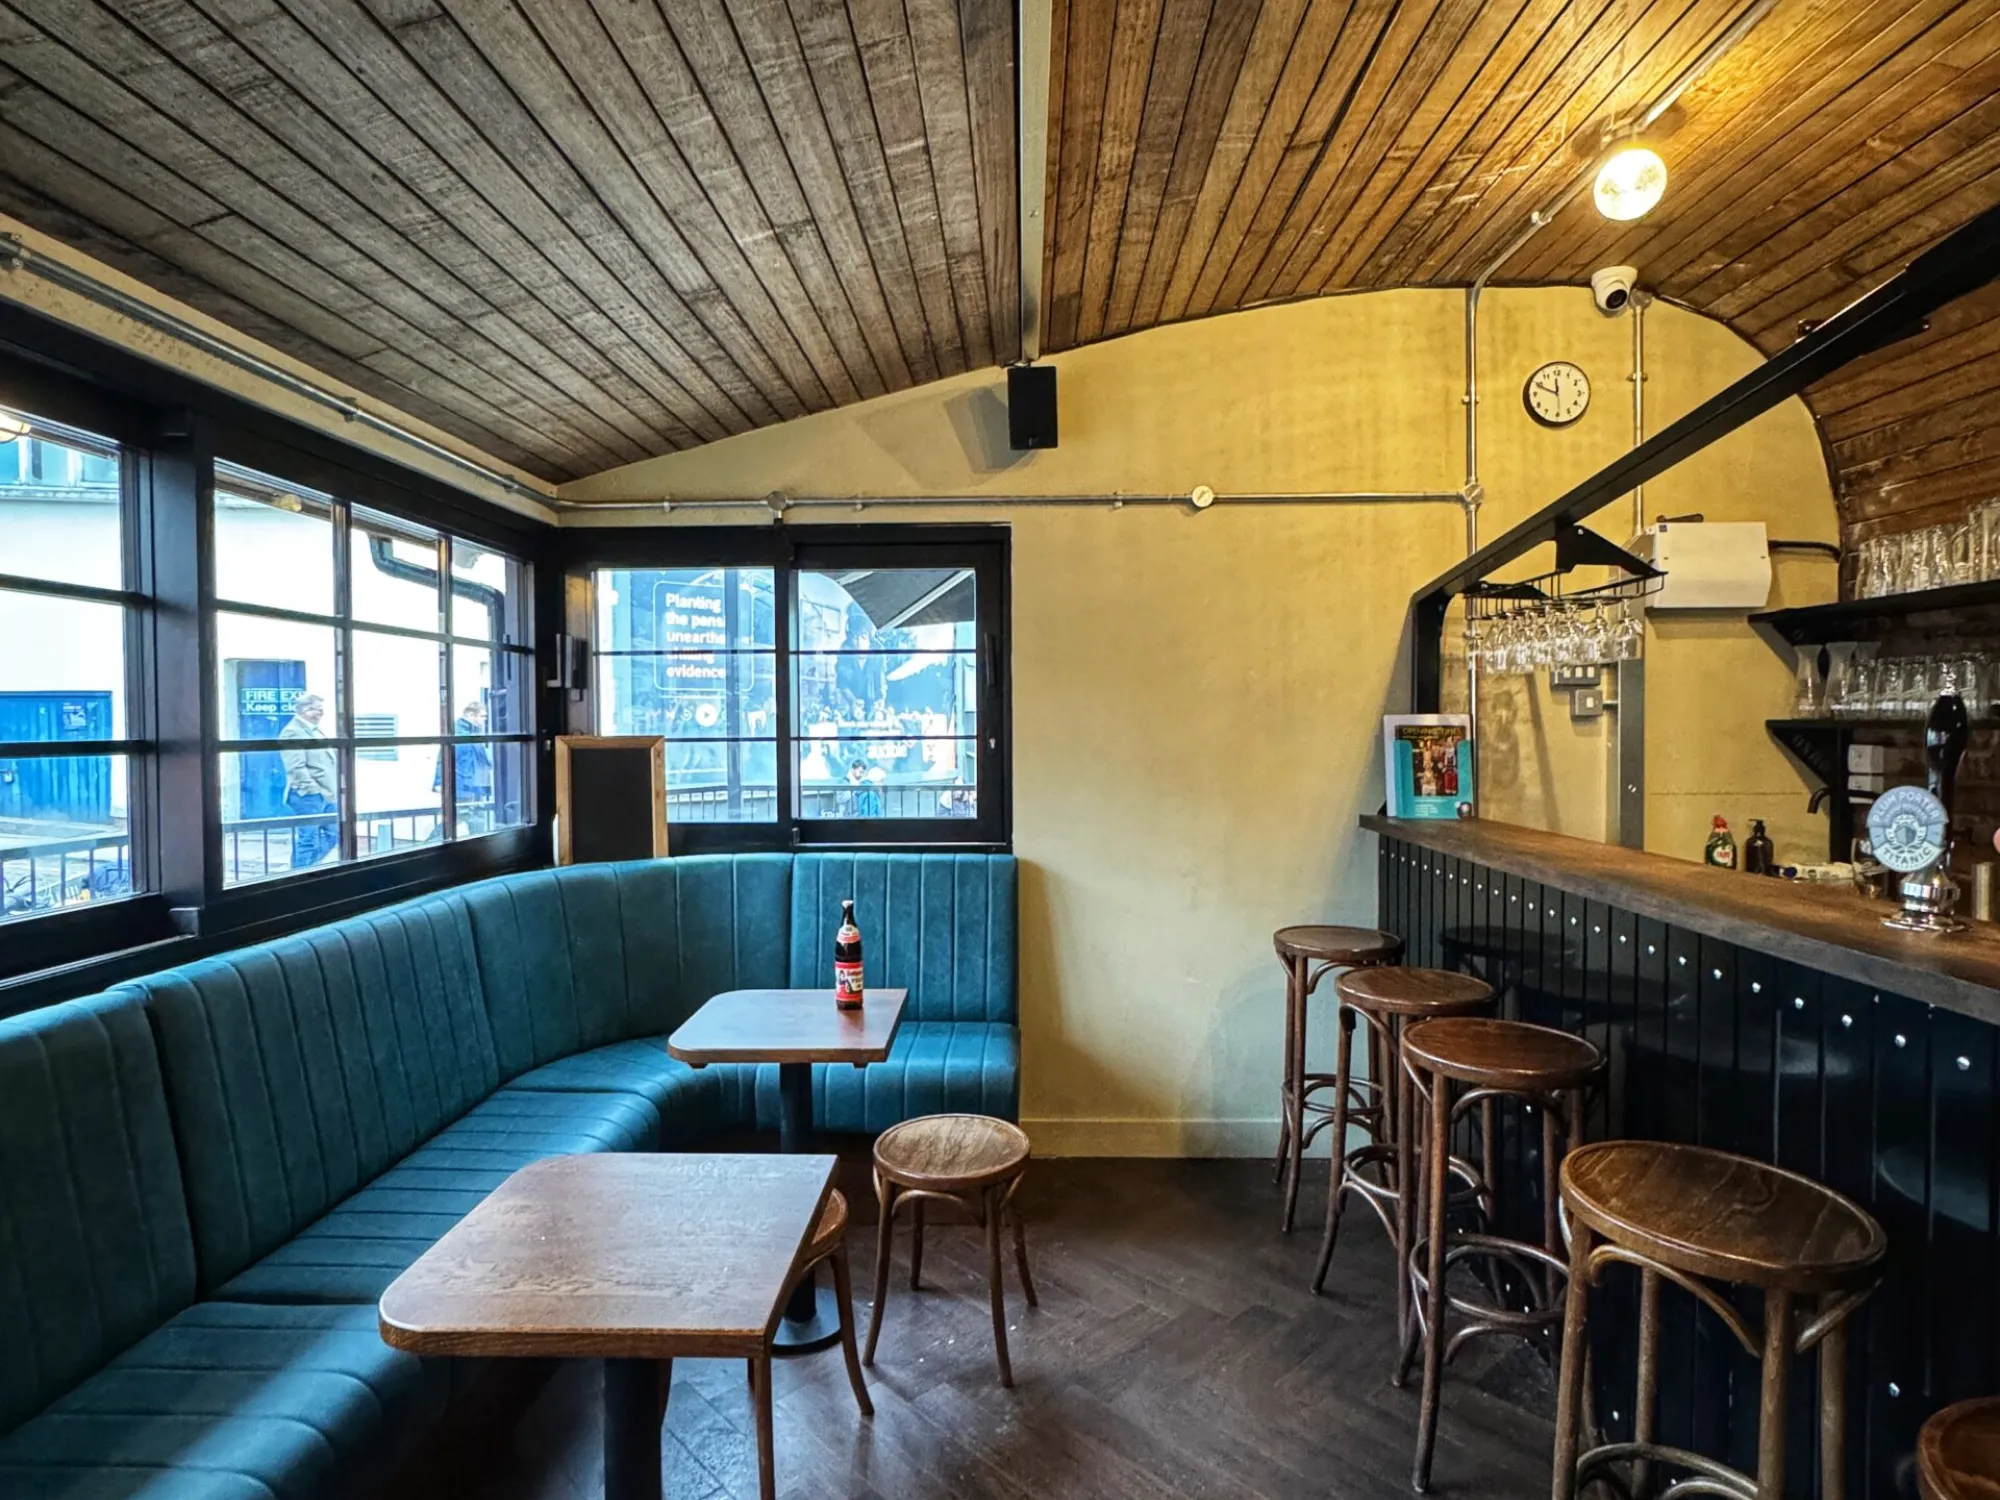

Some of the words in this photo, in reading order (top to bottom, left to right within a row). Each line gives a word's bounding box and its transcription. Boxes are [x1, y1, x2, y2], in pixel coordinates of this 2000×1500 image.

[665, 593, 721, 613] Planting
[665, 611, 688, 625] the
[666, 631, 725, 645] unearthe
[666, 664, 726, 679] evidence
[245, 691, 276, 701] FIRE
[246, 702, 277, 713] Keep
[1873, 795, 1897, 822] PLUM
[1899, 791, 1940, 820] PORTER
[1883, 846, 1932, 864] TITANIC
